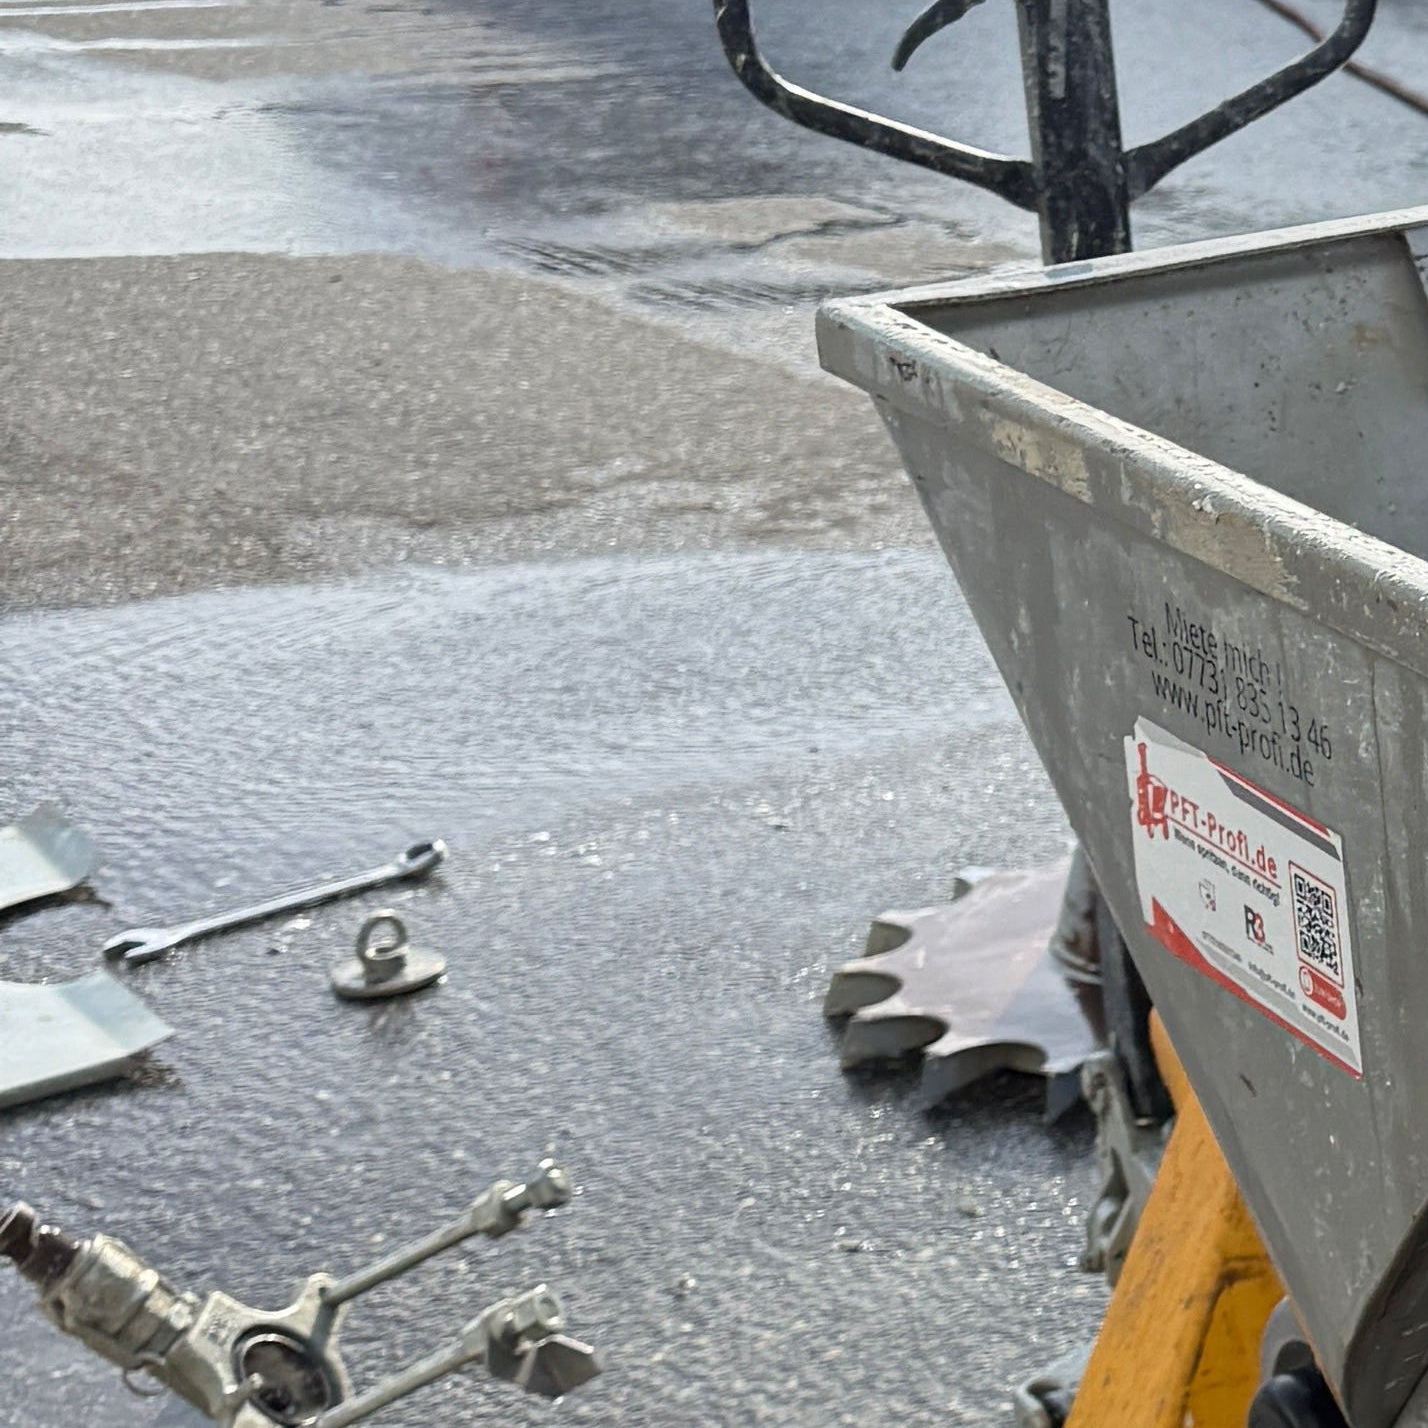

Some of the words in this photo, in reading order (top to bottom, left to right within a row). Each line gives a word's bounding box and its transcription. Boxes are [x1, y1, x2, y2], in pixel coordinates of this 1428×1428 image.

[1164, 602, 1218, 660] Miete
[1224, 638, 1270, 687] mich
[1152, 670, 1315, 787] www.pft-profi.de
[1173, 642, 1228, 701] 07731
[1236, 676, 1271, 724] 835
[1278, 702, 1301, 742] 13
[1307, 719, 1332, 760] 46
[1170, 790, 1278, 880] PFT-Profi.de
[1244, 904, 1265, 943] R3
